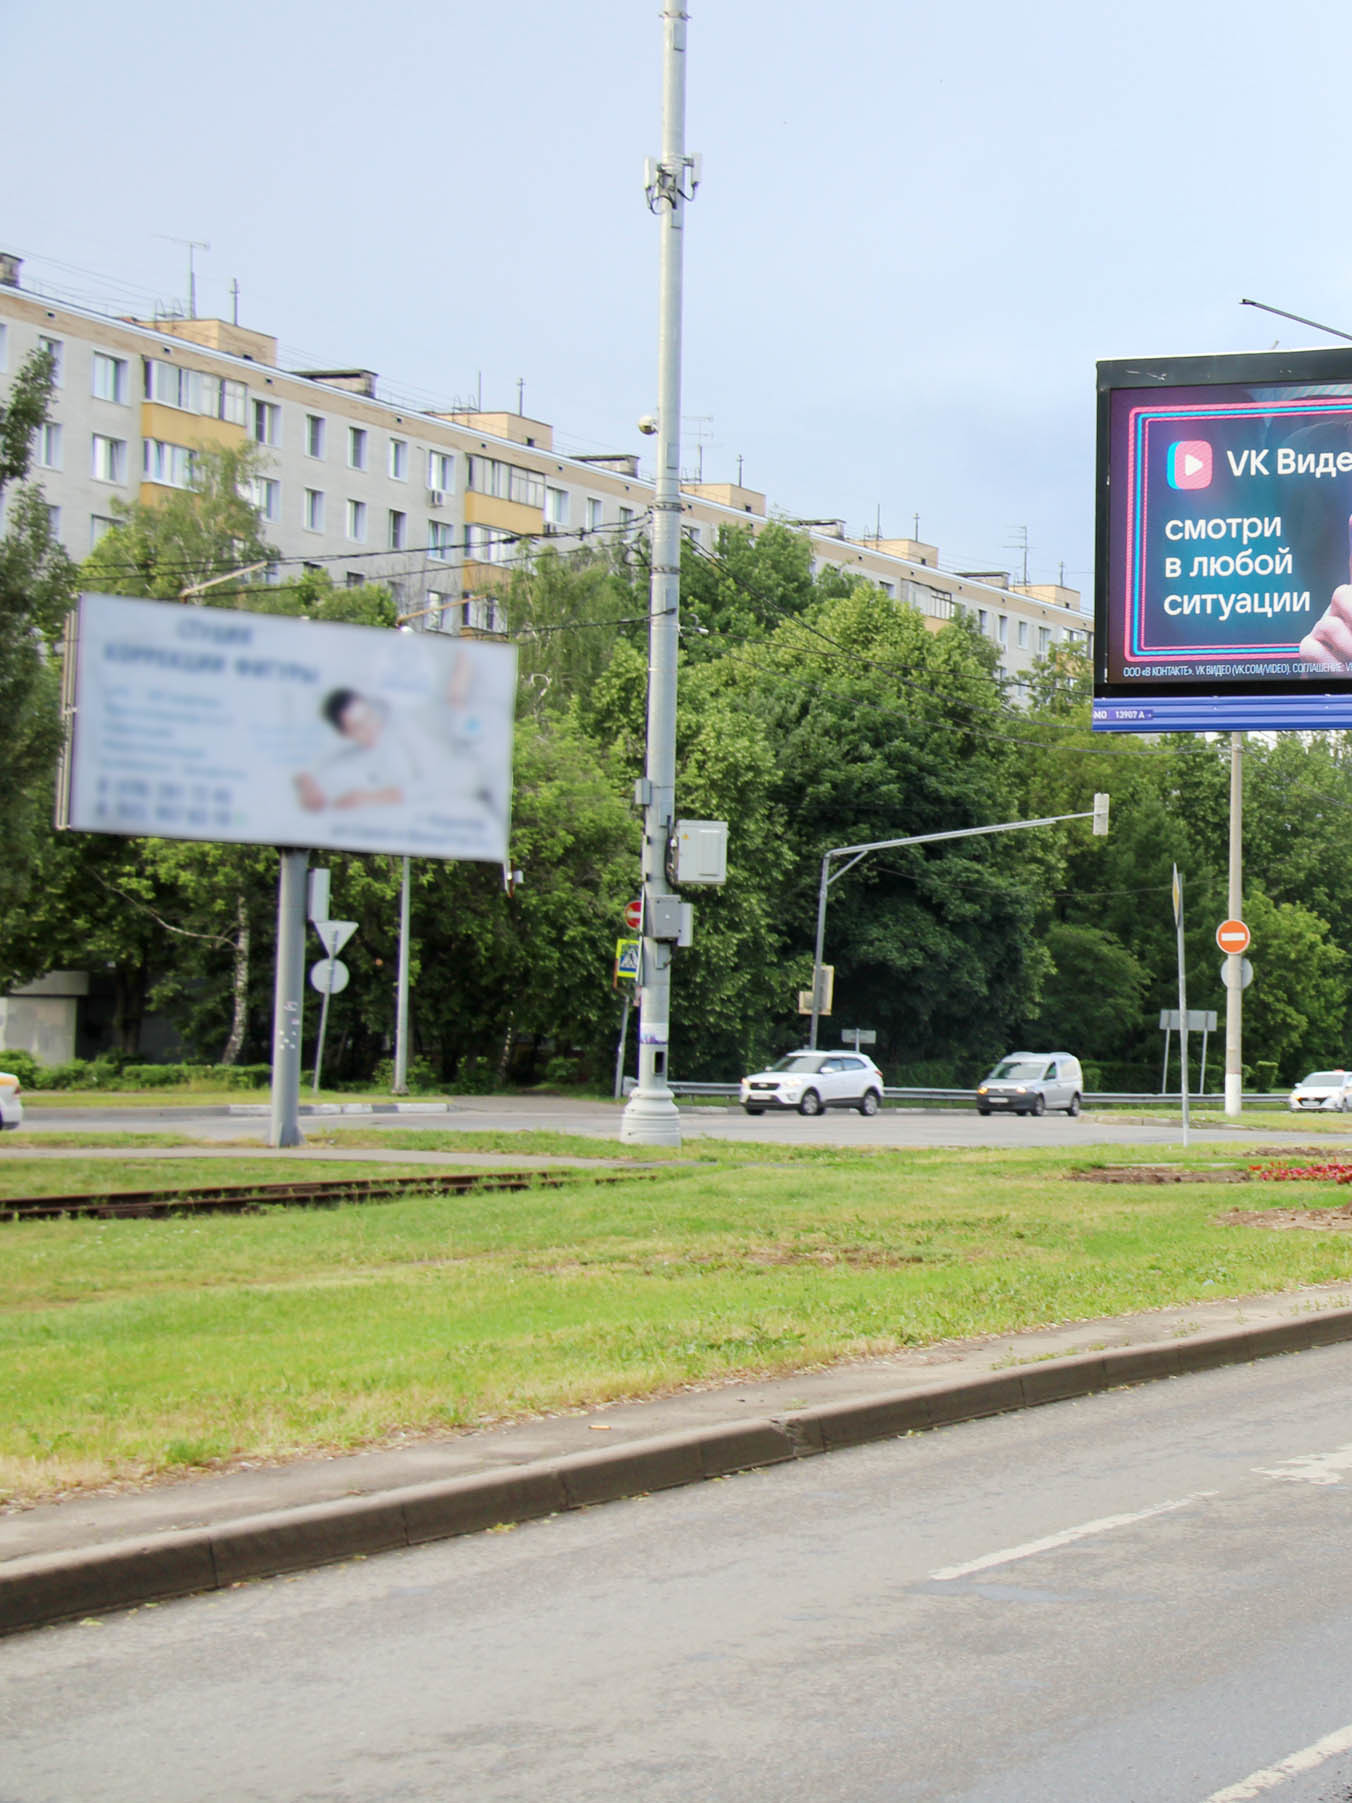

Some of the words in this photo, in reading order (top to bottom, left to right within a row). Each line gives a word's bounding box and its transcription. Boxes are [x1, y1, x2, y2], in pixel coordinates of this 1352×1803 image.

[1226, 448, 1270, 477] VK
[1164, 516, 1282, 545] смотри
[1164, 556, 1182, 578] в
[1189, 547, 1294, 577] любой
[1163, 591, 1311, 622] ситуации
[1123, 666, 1141, 677] ООО
[1206, 664, 1232, 677] ВИДЕО
